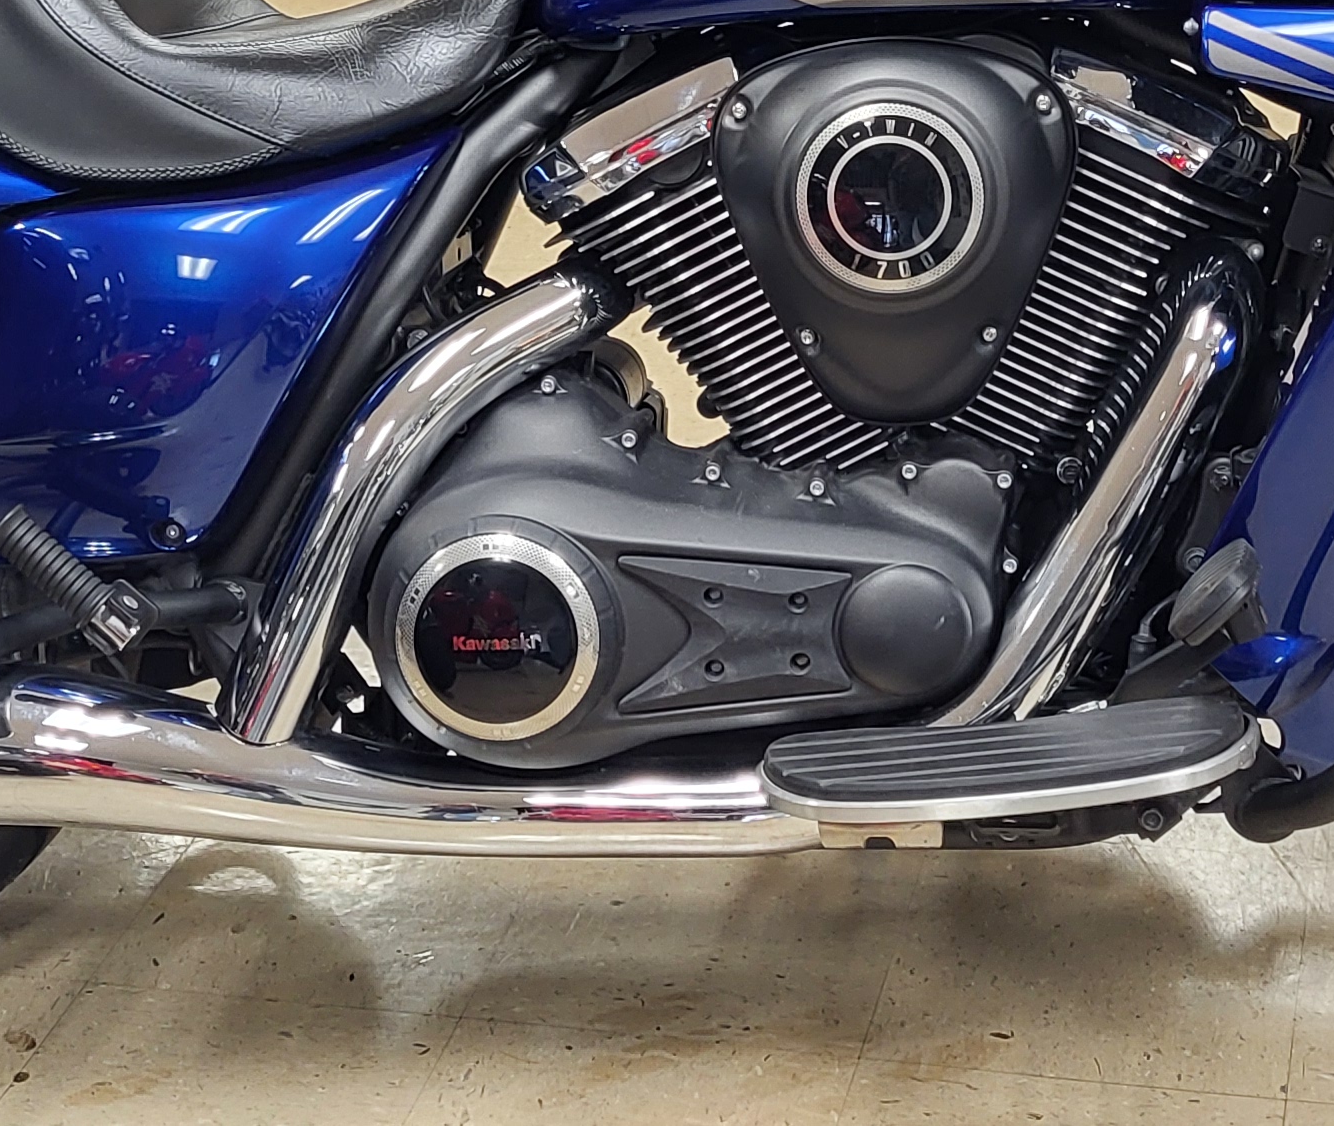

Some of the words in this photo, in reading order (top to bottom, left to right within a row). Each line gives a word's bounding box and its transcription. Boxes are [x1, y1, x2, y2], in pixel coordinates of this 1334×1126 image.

[836, 119, 938, 150] V-TWIN
[850, 251, 935, 279] 1700
[452, 631, 542, 652] Kawasaki
